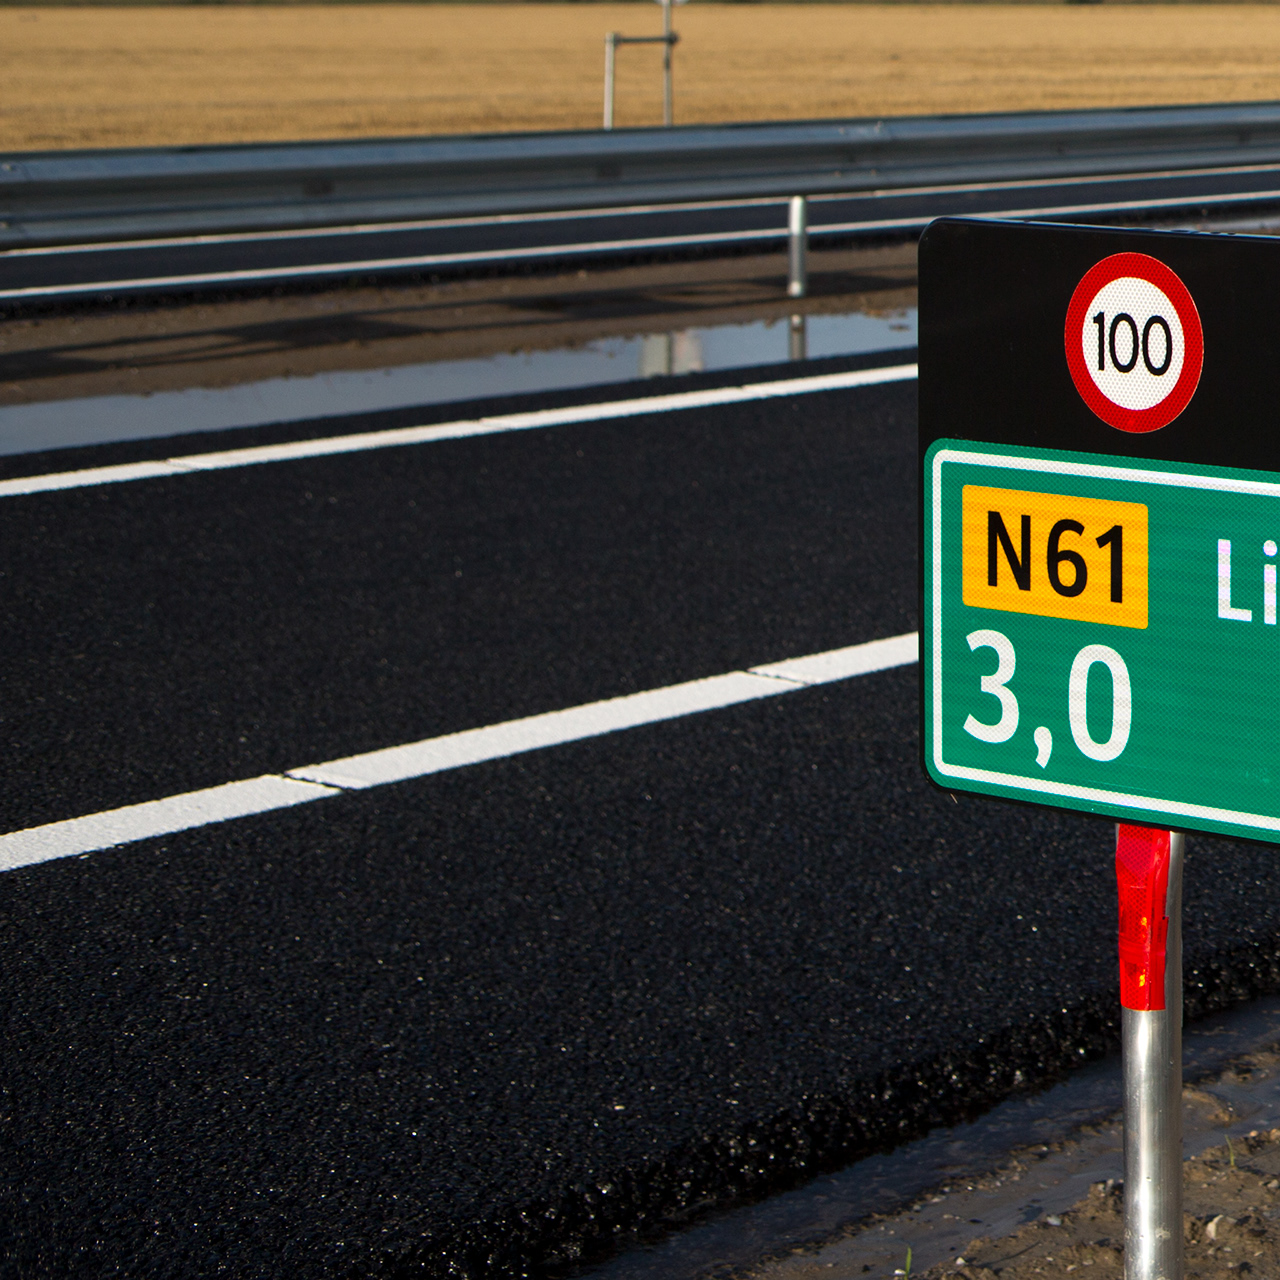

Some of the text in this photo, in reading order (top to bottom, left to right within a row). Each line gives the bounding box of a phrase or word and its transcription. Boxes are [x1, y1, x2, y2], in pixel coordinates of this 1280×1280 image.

[1092, 311, 1173, 377] 100
[987, 510, 1124, 604] N61
[1217, 538, 1278, 625] Li
[962, 629, 1132, 769] 3,0
